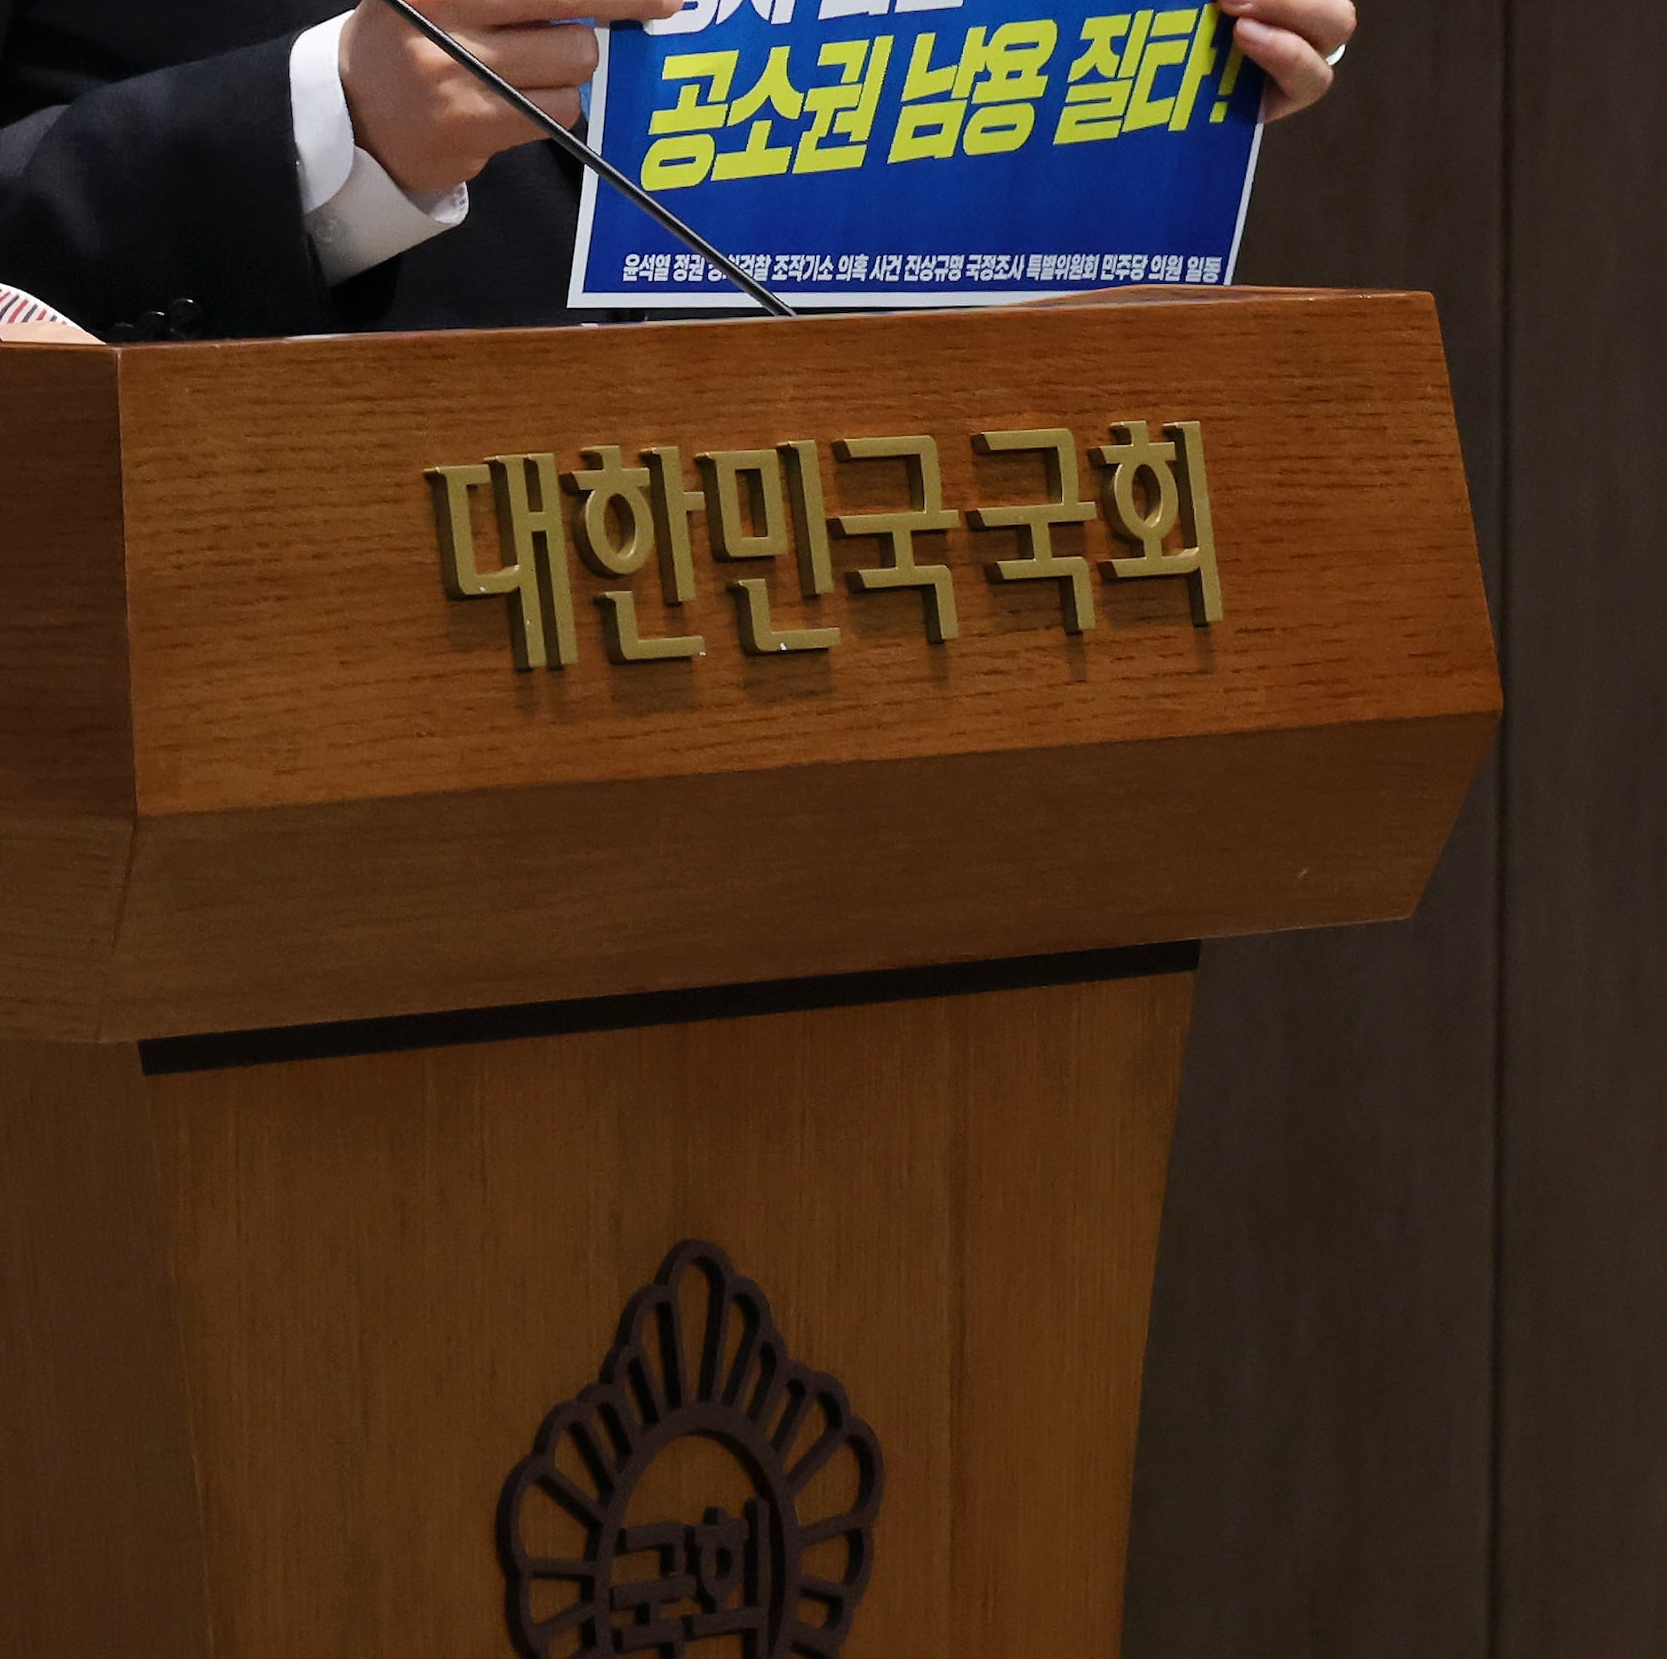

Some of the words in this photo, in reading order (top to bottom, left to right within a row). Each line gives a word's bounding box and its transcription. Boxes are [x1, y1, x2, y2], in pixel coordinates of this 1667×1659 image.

[639, 37, 892, 194] 공소권
[887, 18, 1059, 165] 남용
[1053, 3, 1245, 145] 질타!
[622, 254, 671, 282] 윤석열
[673, 254, 705, 282] 정권
[771, 254, 835, 281] 조작기소
[836, 254, 869, 281] 의혹
[869, 254, 901, 281] 사건
[904, 254, 964, 282] 진상규명
[966, 254, 1025, 282] 국정조사
[1026, 253, 1100, 282] 특별위원회
[1100, 254, 1148, 282] 민주당
[1148, 254, 1184, 282] 의원
[1184, 256, 1222, 283] 일동
[425, 419, 1224, 671] 대한민국국회
[609, 1498, 769, 1659] 국회
